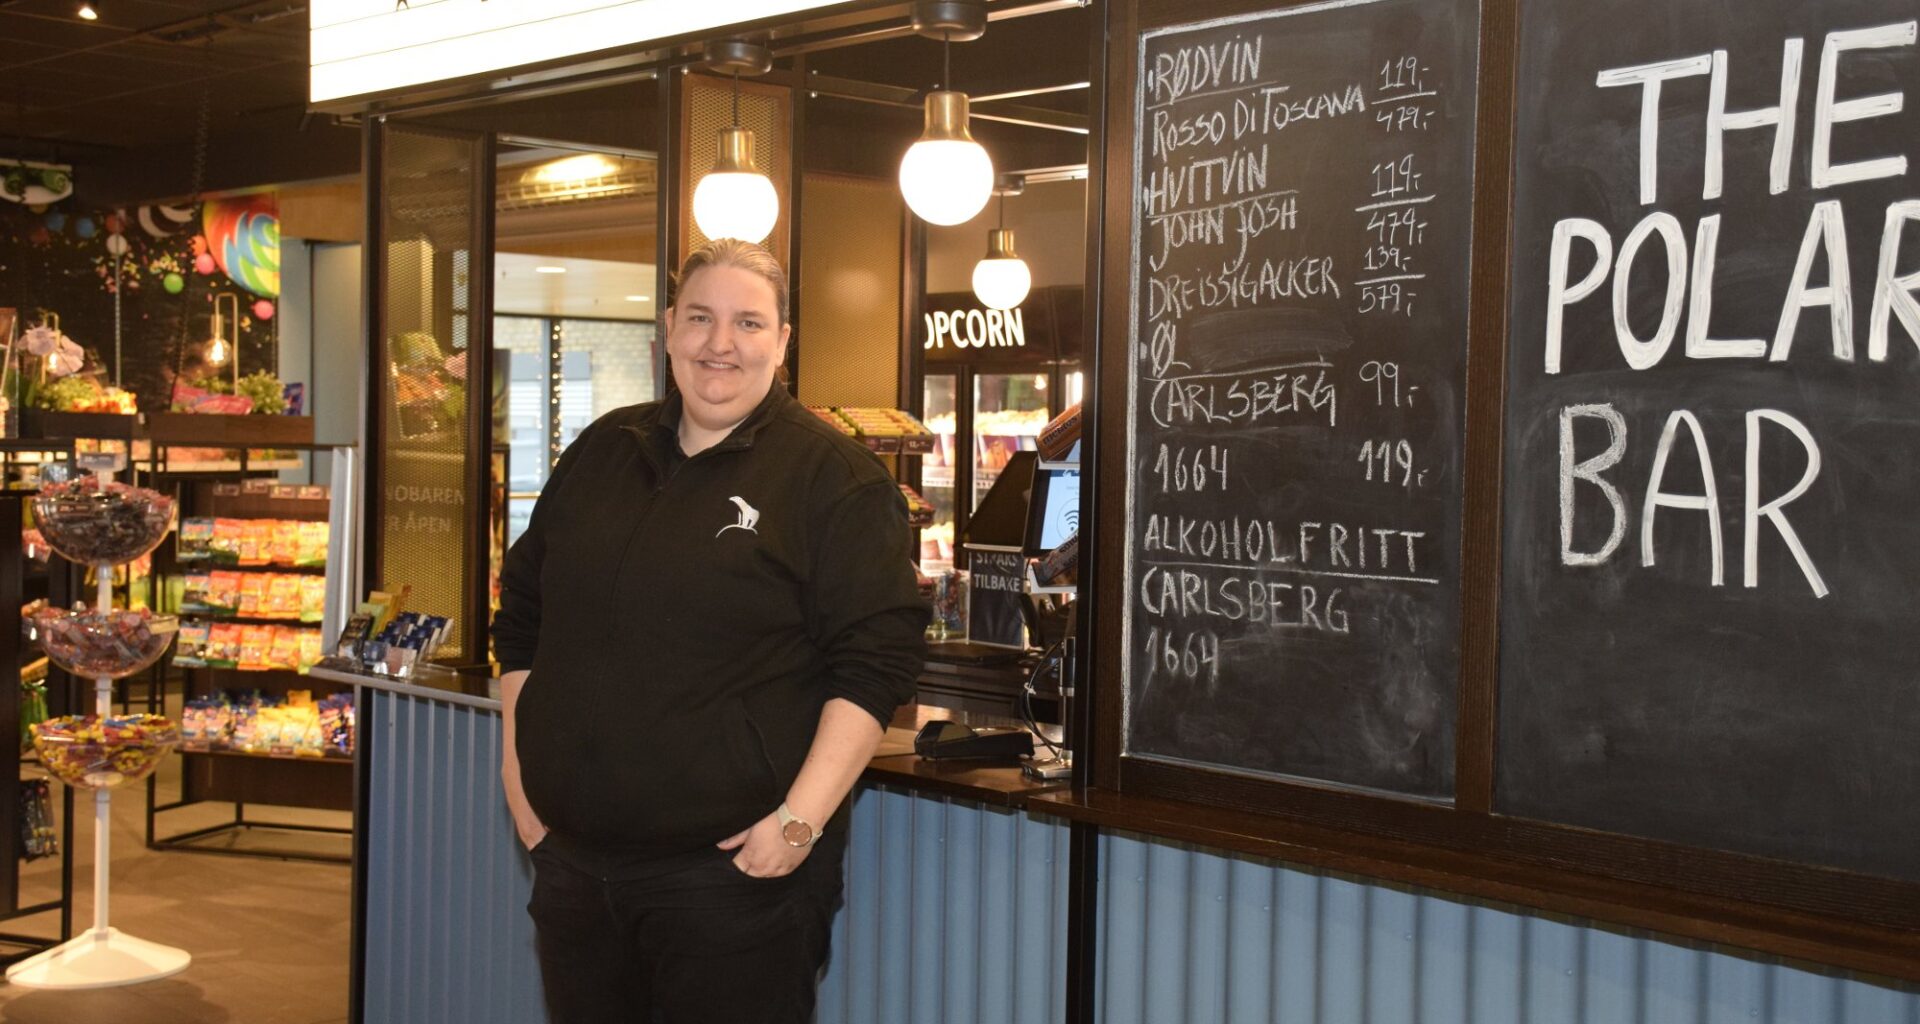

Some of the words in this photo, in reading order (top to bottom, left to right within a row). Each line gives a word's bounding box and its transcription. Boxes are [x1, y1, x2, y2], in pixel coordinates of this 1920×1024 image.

[1596, 21, 1917, 205] THE
[1149, 144, 1268, 215] HVITVIN
[1149, 206, 1224, 272] JOHN
[1223, 198, 1299, 274] JOSH
[1544, 199, 1920, 374] POLAR
[1151, 320, 1192, 378] ØL
[1150, 370, 1336, 428] CARLSBERG
[1154, 443, 1228, 493] 1664
[1559, 403, 1829, 598] BAR
[974, 573, 1021, 592] TILBAKE
[1141, 566, 1350, 634] CARLSBERG
[1145, 626, 1219, 680] 1664
